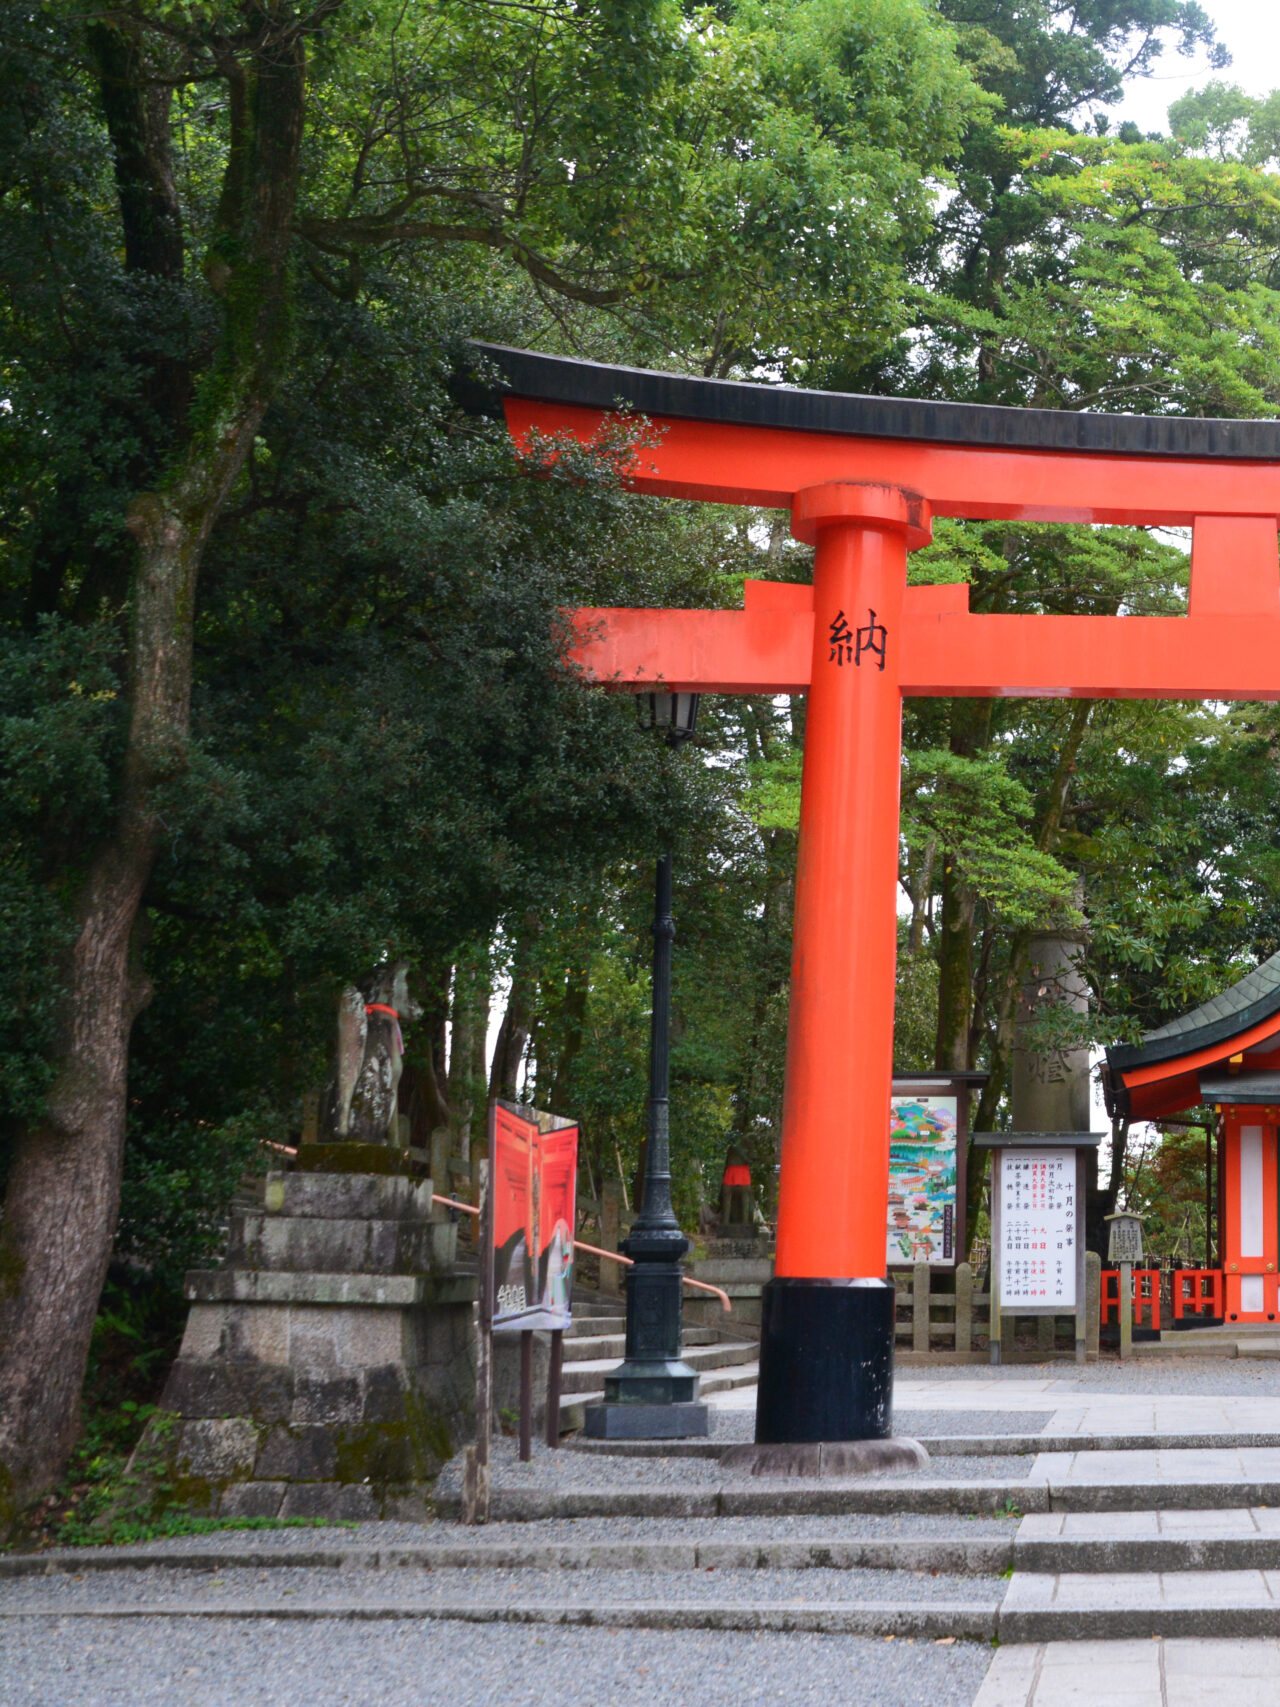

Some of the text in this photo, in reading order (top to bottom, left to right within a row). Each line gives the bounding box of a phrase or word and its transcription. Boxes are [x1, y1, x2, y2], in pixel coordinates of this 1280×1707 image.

[829, 608, 888, 671] 納
[1065, 1182, 1074, 1247] 十月の祭事
